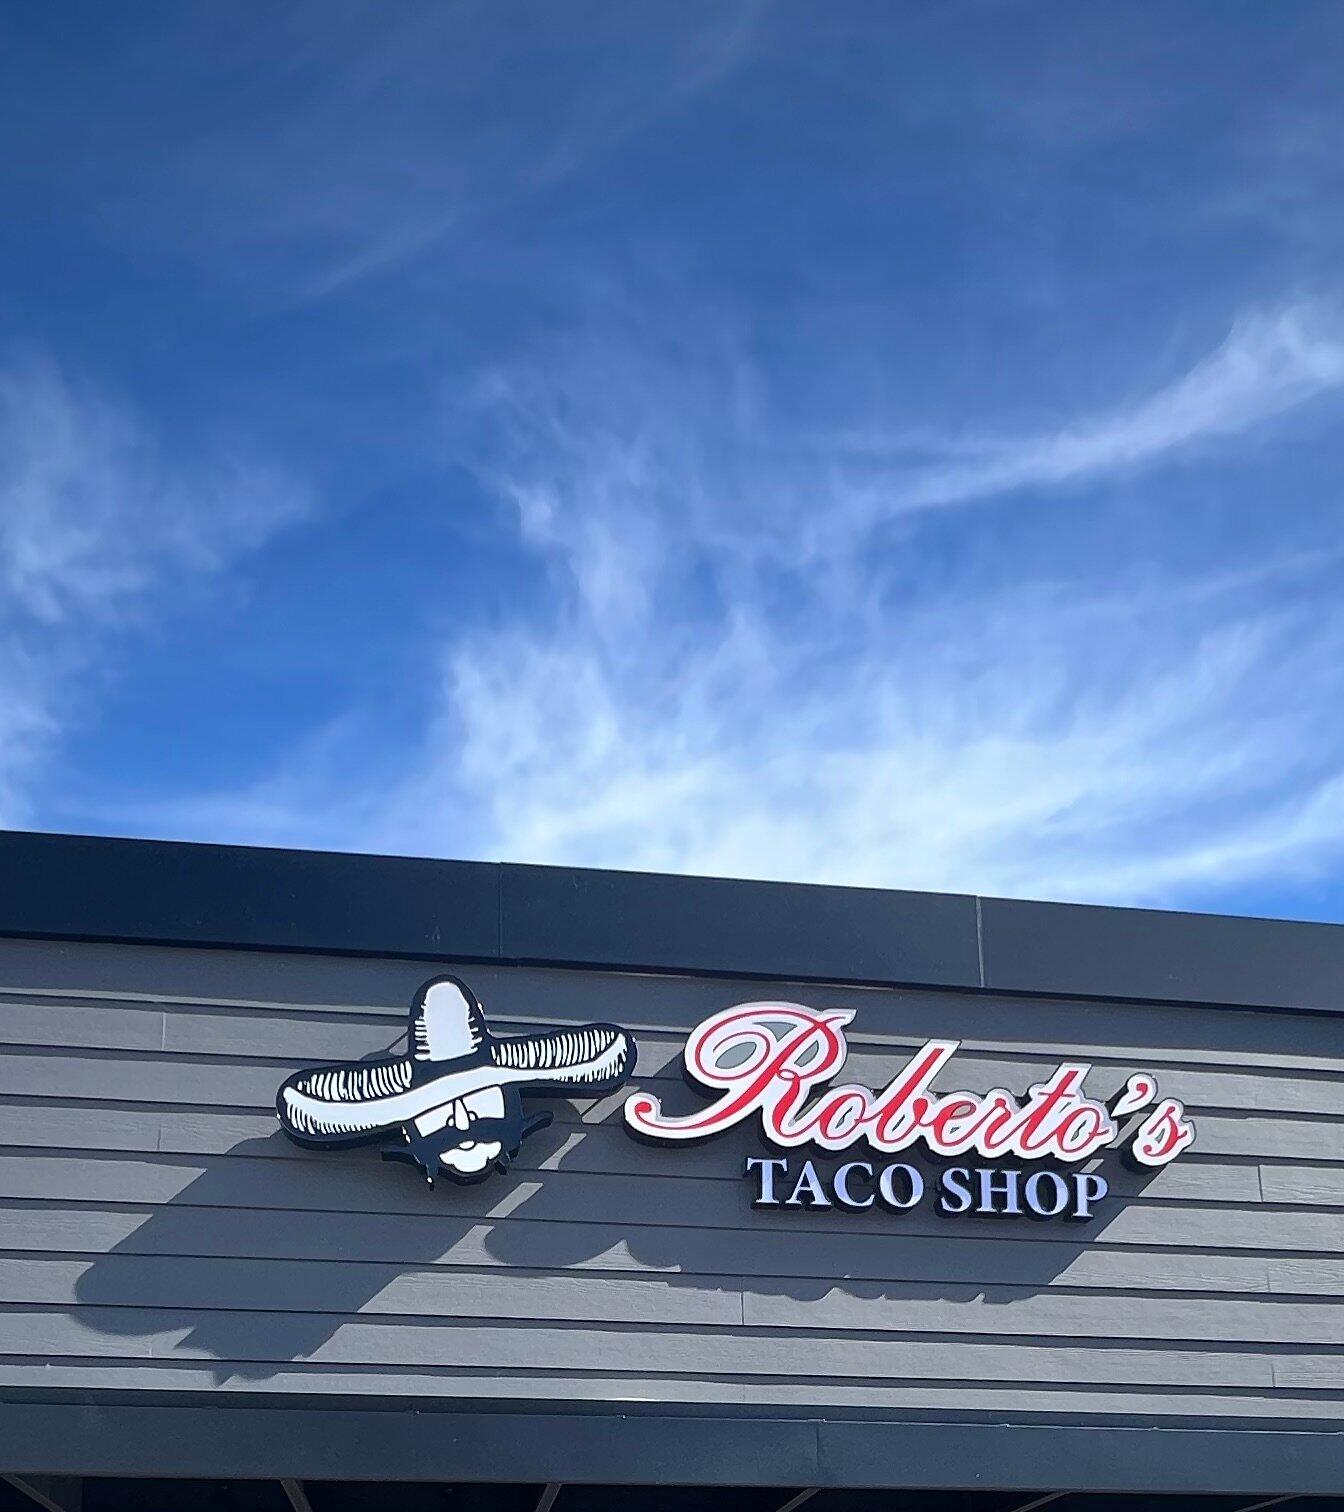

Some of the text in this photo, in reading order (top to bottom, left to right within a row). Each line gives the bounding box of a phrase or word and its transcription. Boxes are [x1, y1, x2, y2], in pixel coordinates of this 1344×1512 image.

[626, 1003, 1194, 1165] Roberto's
[747, 1157, 1108, 1217] TACO SHOP
